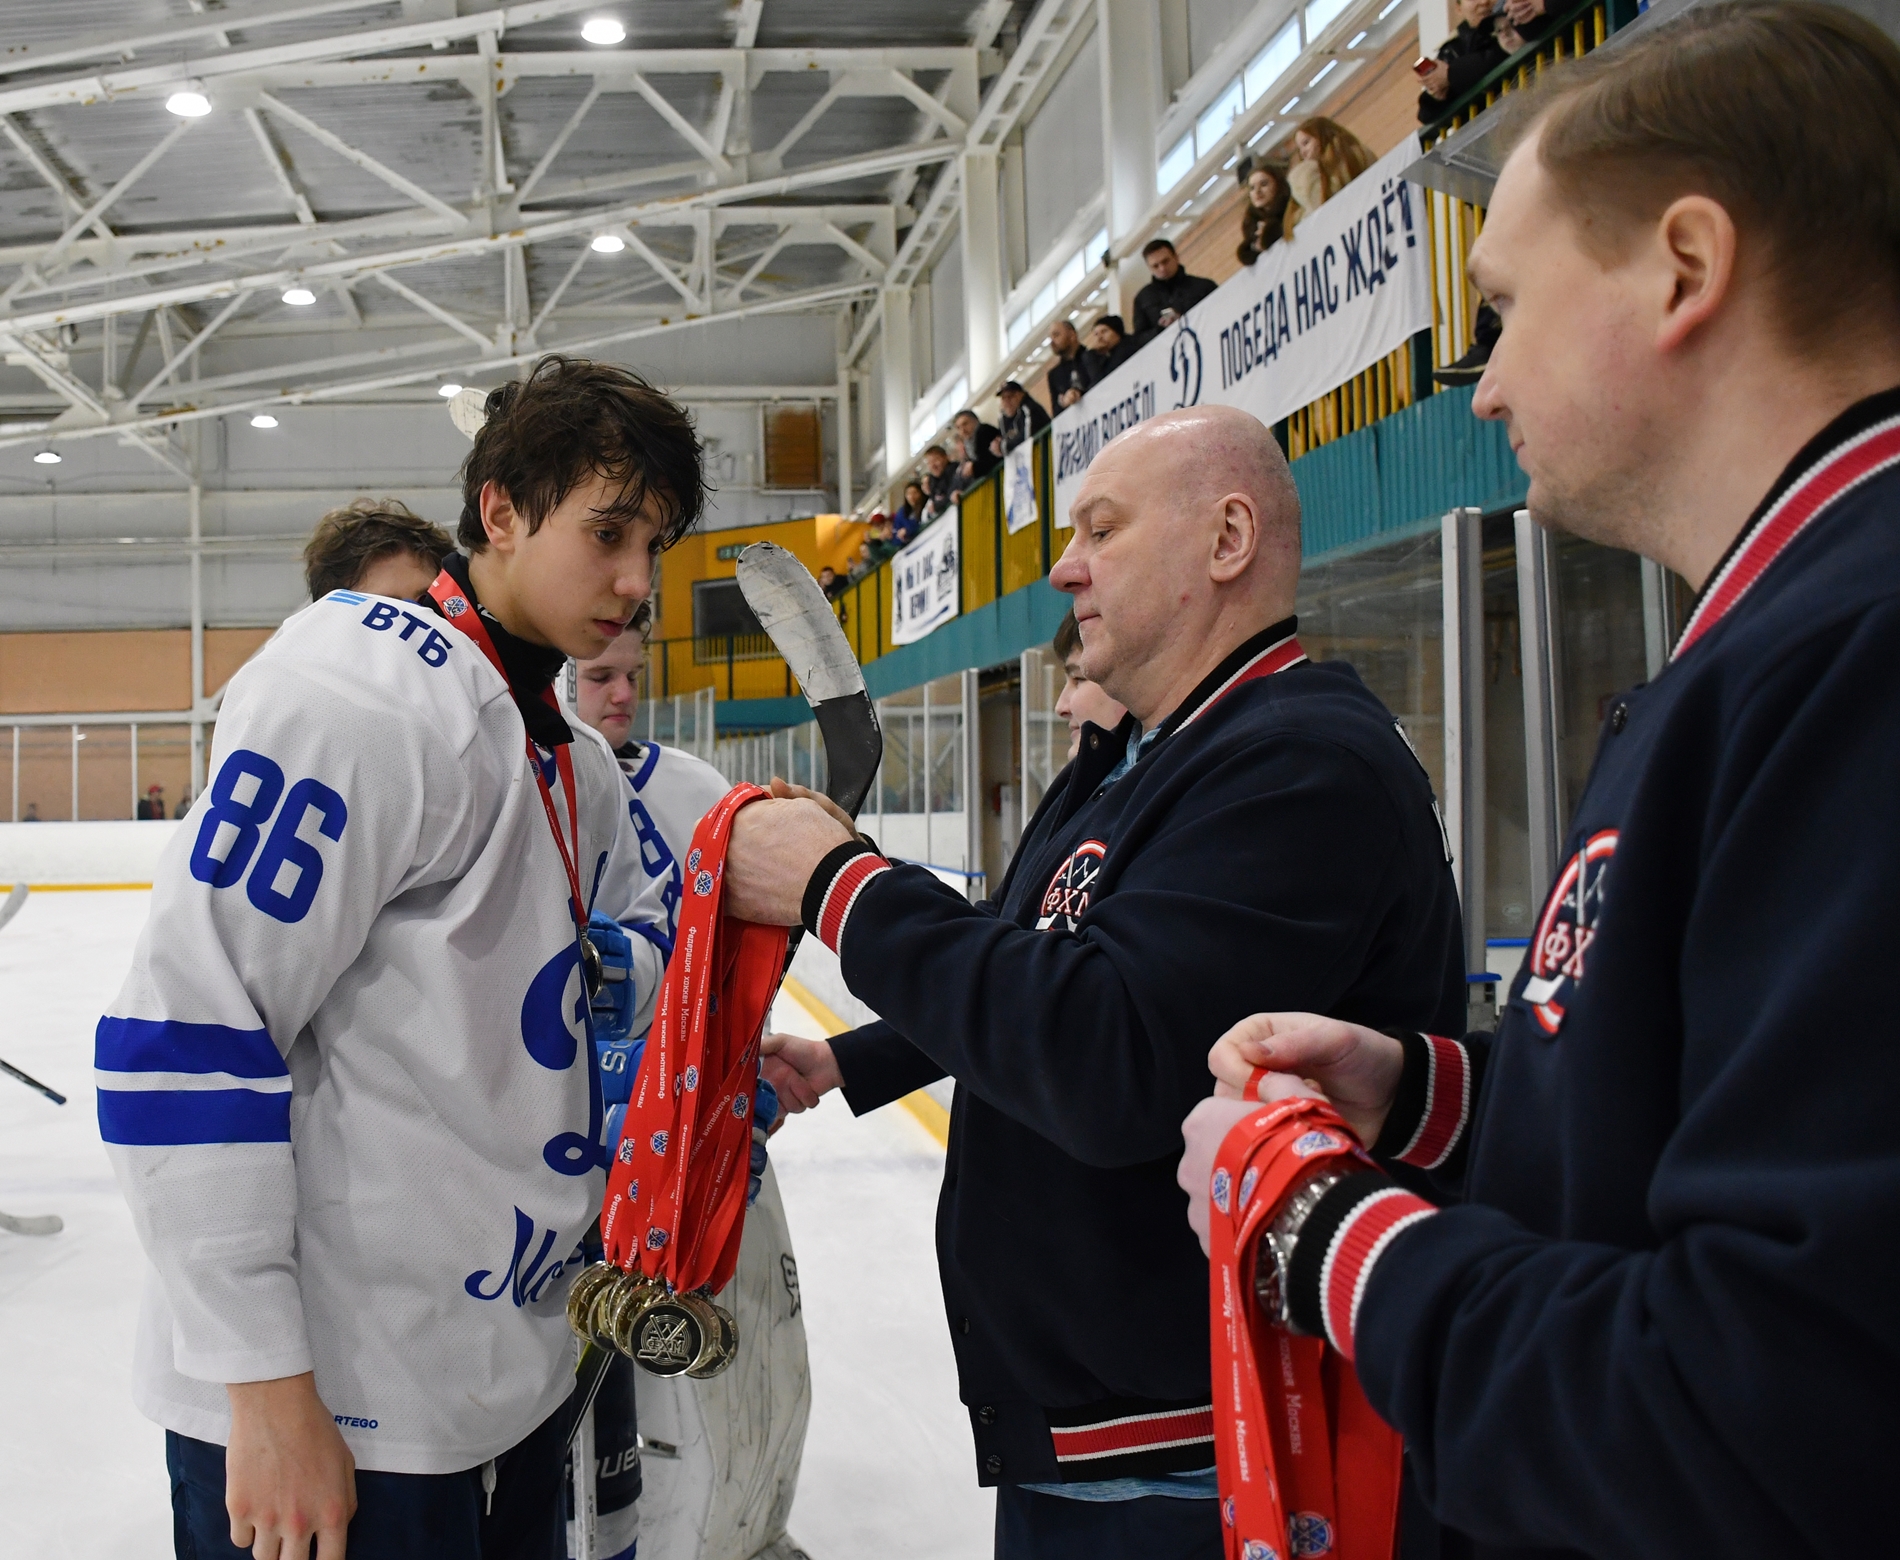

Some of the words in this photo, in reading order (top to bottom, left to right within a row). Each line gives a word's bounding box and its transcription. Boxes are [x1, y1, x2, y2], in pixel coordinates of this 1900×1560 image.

[1220, 283, 1291, 390] ПОБЕДА
[1294, 245, 1339, 335] НАС
[361, 601, 453, 668] ВТБ
[567, 657, 577, 700] CC
[189, 749, 348, 924] 86
[684, 926, 698, 973] Федерация
[661, 982, 670, 1017] Москвы
[682, 976, 690, 1005] хоккея
[680, 1008, 690, 1042] Москвы
[658, 1052, 667, 1099] Федерация
[703, 1094, 731, 1137] Федерация
[715, 1149, 731, 1184] Москвы
[604, 1194, 622, 1240] Федерация
[334, 1415, 379, 1429] RTEGO
[1286, 1394, 1302, 1455] Москвы
[1235, 1419, 1250, 1482] Москвы
